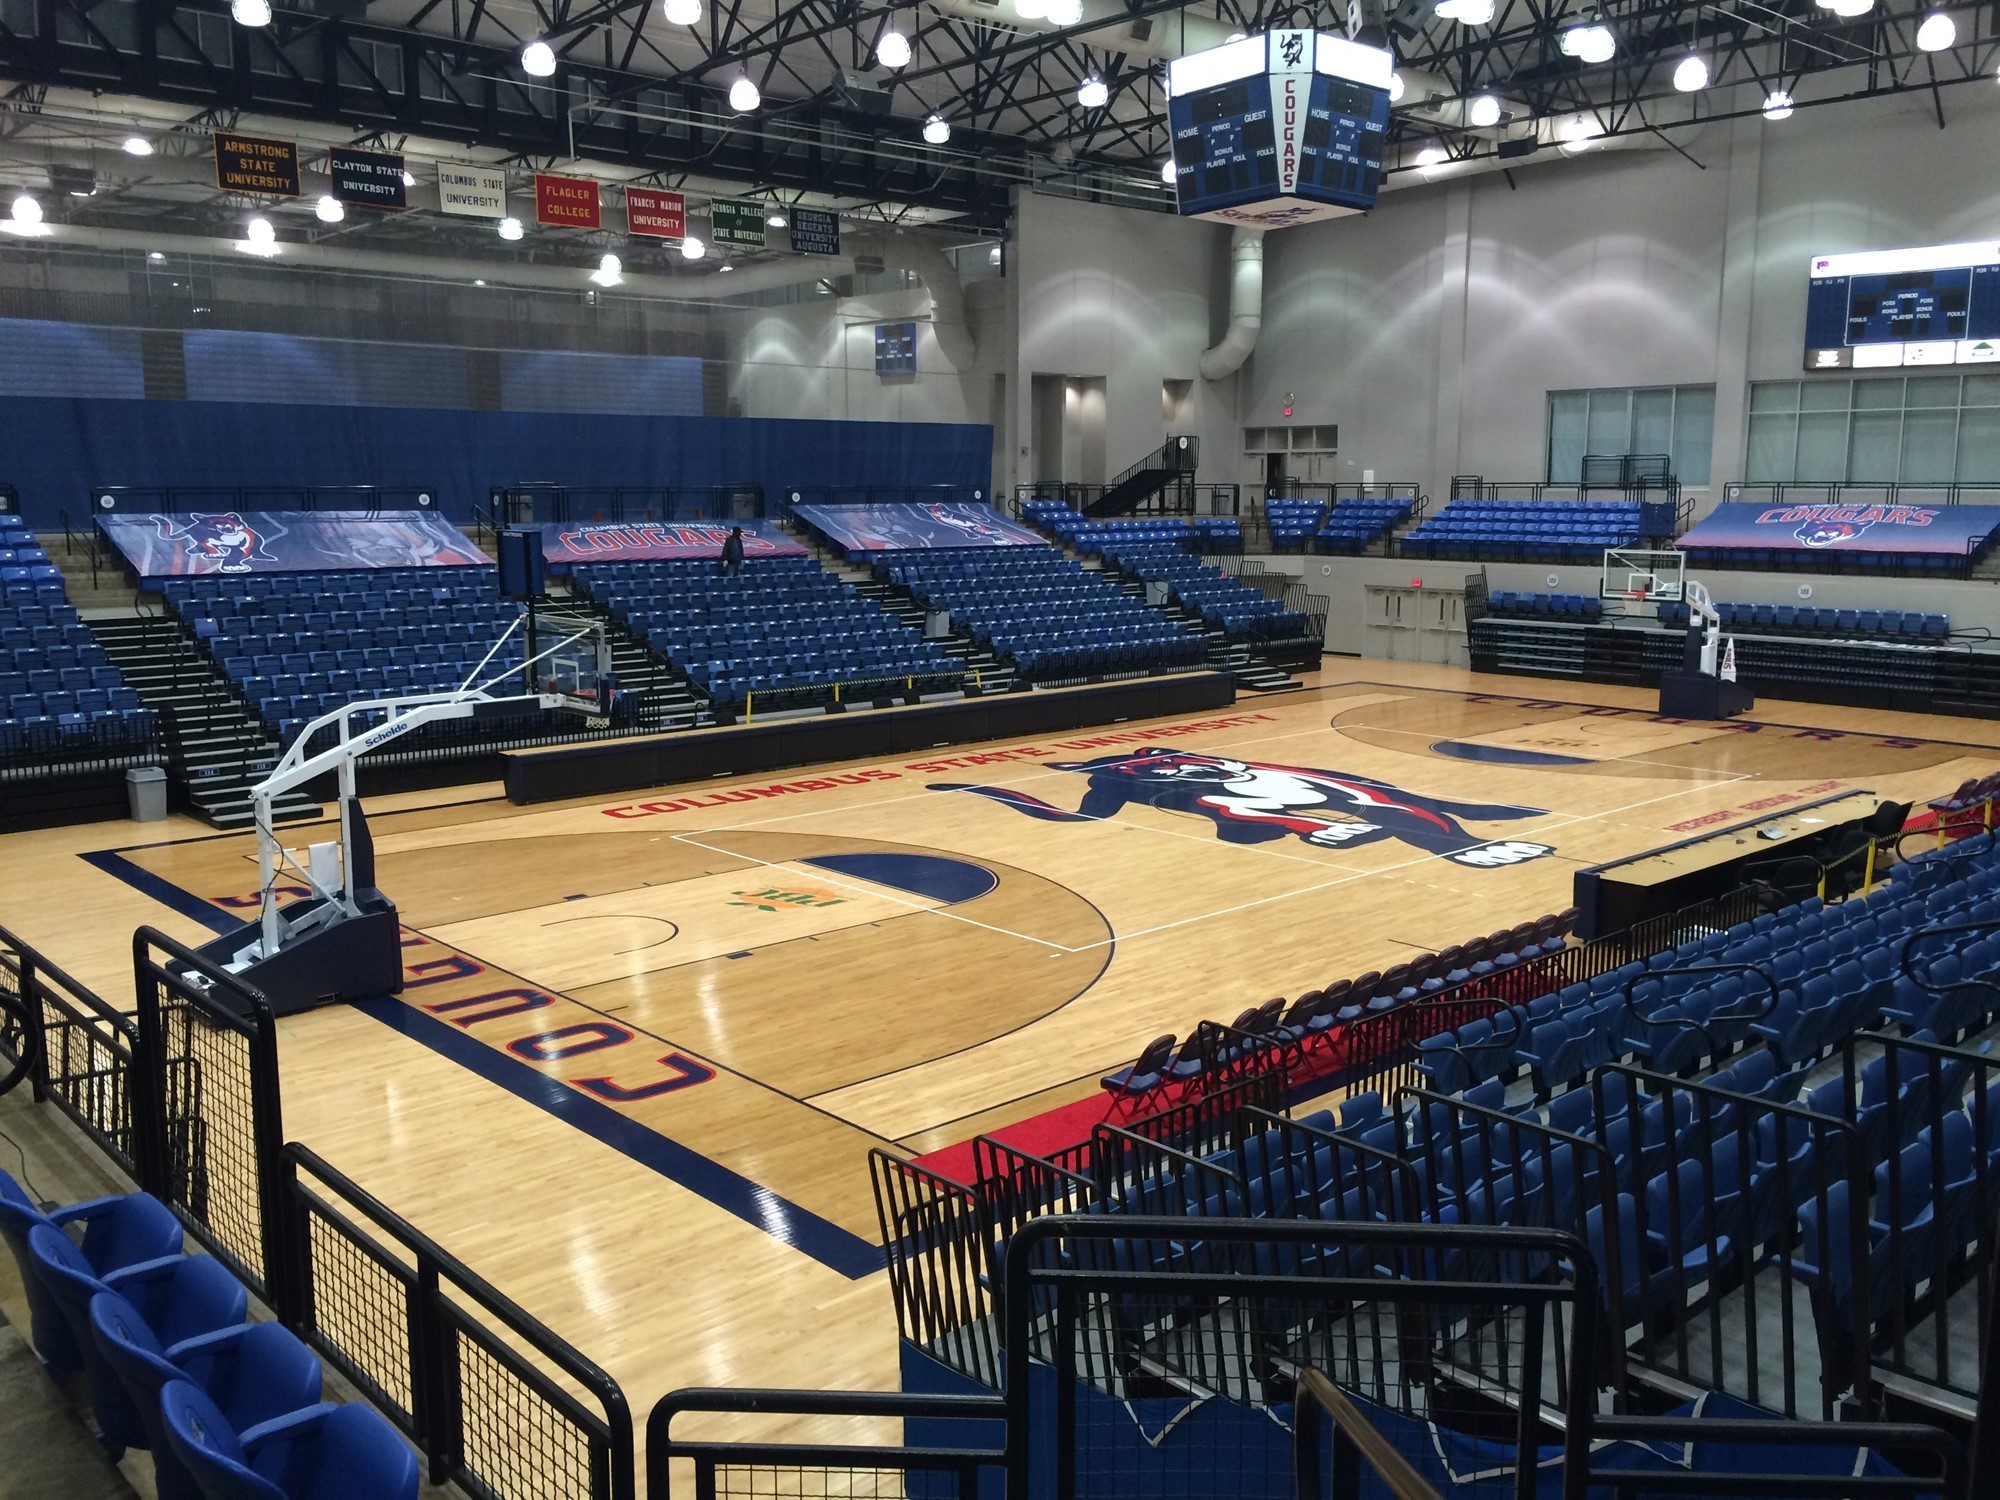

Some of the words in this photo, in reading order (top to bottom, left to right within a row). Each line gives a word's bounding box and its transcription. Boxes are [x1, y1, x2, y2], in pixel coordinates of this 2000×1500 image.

[1244, 110, 1267, 122] GUEST
[1310, 108, 1330, 120] HOME
[1211, 122, 1231, 132] PERIOD
[1339, 118, 1355, 128] PERIOD
[1365, 121, 1383, 132] GUEST
[1177, 127, 1199, 139] HOME
[1283, 79, 1296, 187] COUGARS
[224, 141, 289, 159] ARMSTRONG
[1214, 146, 1233, 156] BONUS
[1256, 147, 1275, 157] FOULS
[1302, 146, 1317, 155] FOULS
[1335, 143, 1351, 152] BONUS
[240, 158, 276, 172] STATE
[1206, 158, 1226, 168] PLAYER
[1232, 154, 1247, 163] FOUL
[1326, 151, 1343, 161] PLAYER
[1348, 156, 1359, 165] FOUL
[1366, 160, 1380, 168] FOULS
[332, 160, 372, 173] CLAYTON
[376, 166, 404, 177] STATE
[1178, 165, 1194, 175] FOULS
[226, 172, 290, 189] UNIVERSITY
[343, 180, 396, 195] UNIVERSITY
[441, 173, 477, 187] COLUMBUS
[483, 178, 503, 190] STATE
[546, 185, 590, 200] FLAGLER
[446, 193, 499, 208] UNIVERSITY
[630, 196, 655, 209] FRANCIS
[660, 200, 682, 212] MARION
[547, 204, 591, 218] COLLEGE
[712, 203, 736, 214] GEORGIA
[740, 206, 764, 218] COLLEGE
[797, 211, 832, 224] GEORGIA
[633, 214, 680, 229] UNIVERSITY
[796, 220, 833, 233] REGENTS
[713, 227, 730, 238] STATE
[734, 229, 764, 242] UNIVERSITY
[791, 230, 838, 243] UNIVERSITY
[796, 241, 834, 253] AUGUSTA
[1755, 506, 1940, 526] COUGARS
[580, 523, 629, 533] COLUMBUS
[665, 522, 725, 530] UNIVERSITY
[365, 723, 407, 747] Schelde
[601, 769, 902, 819] COLUMBUS
[905, 746, 1058, 774] STATE
[1055, 713, 1279, 750] UNIVERSITY
